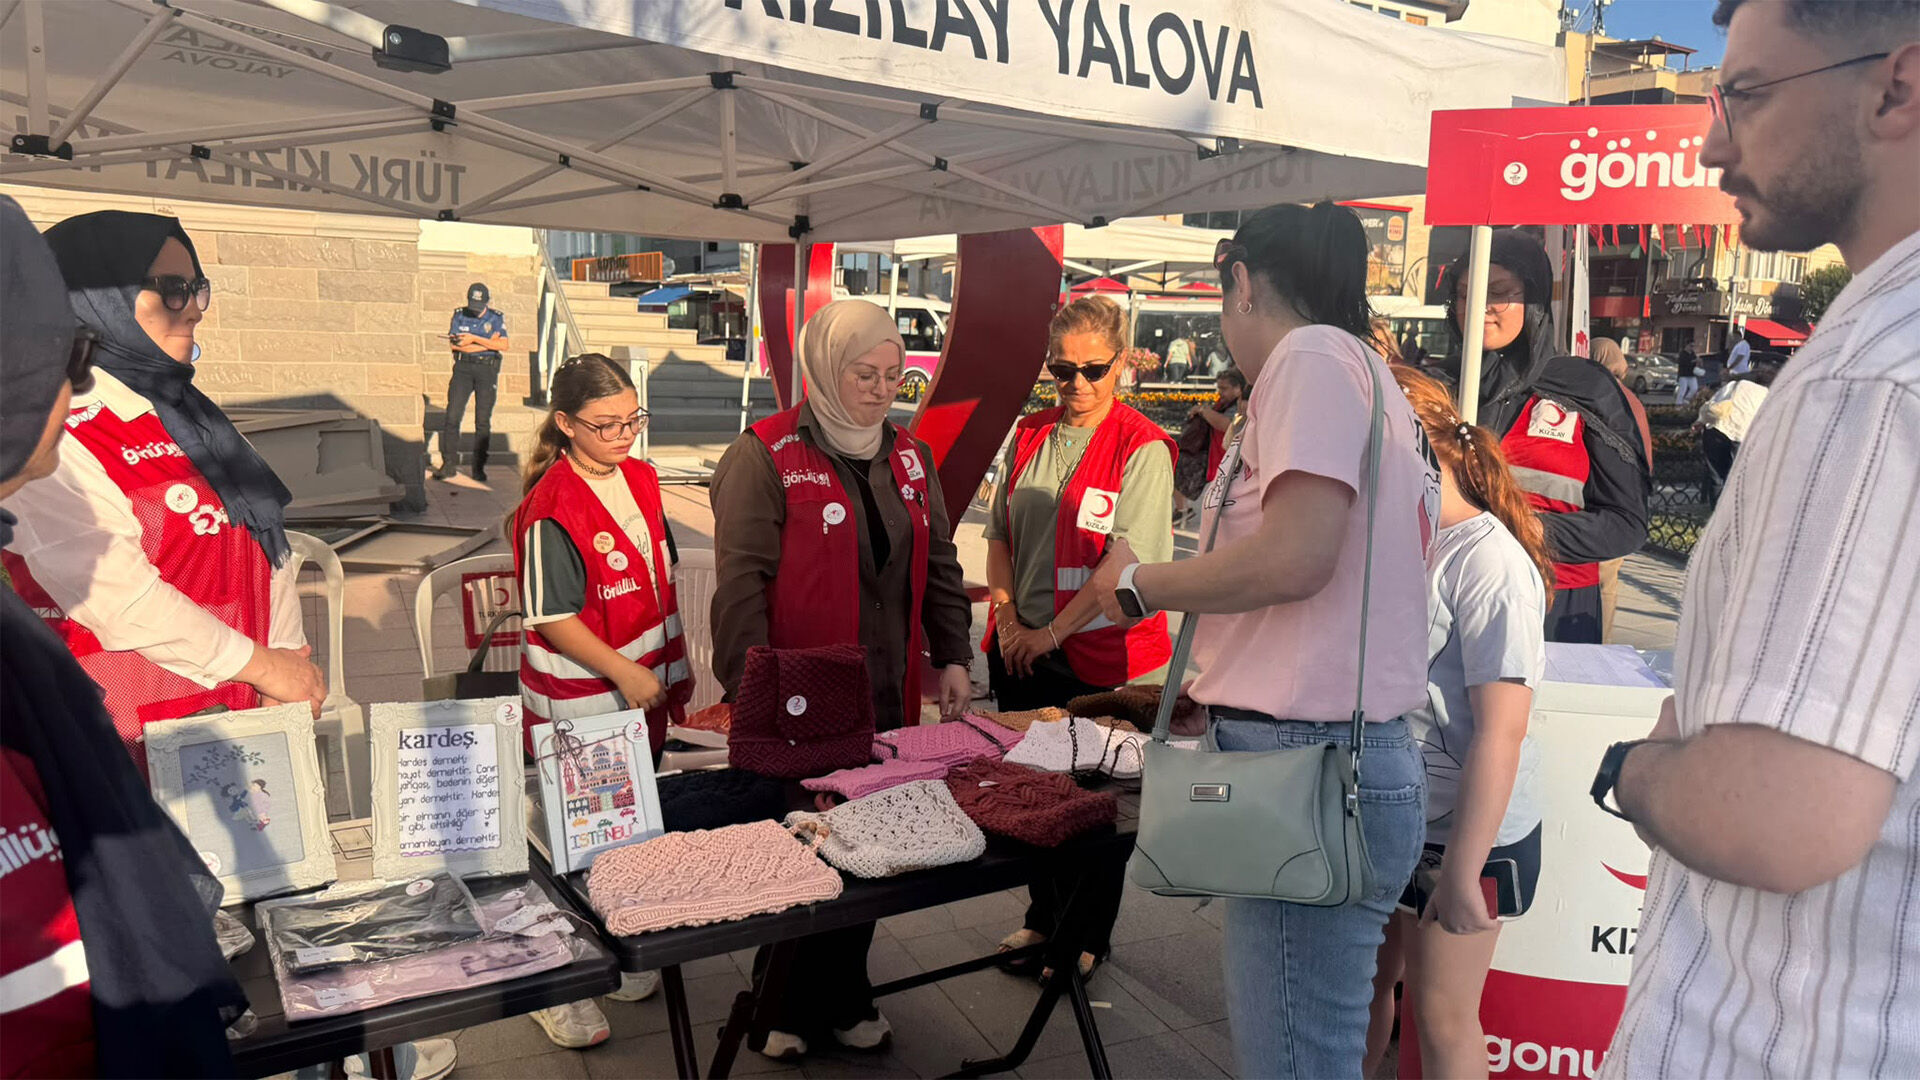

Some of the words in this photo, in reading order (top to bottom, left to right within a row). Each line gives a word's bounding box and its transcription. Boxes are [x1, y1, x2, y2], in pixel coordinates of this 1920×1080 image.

[724, 0, 1010, 64] ILAY
[1037, 0, 1263, 109] YALOVA
[398, 728, 478, 749] kardeş.
